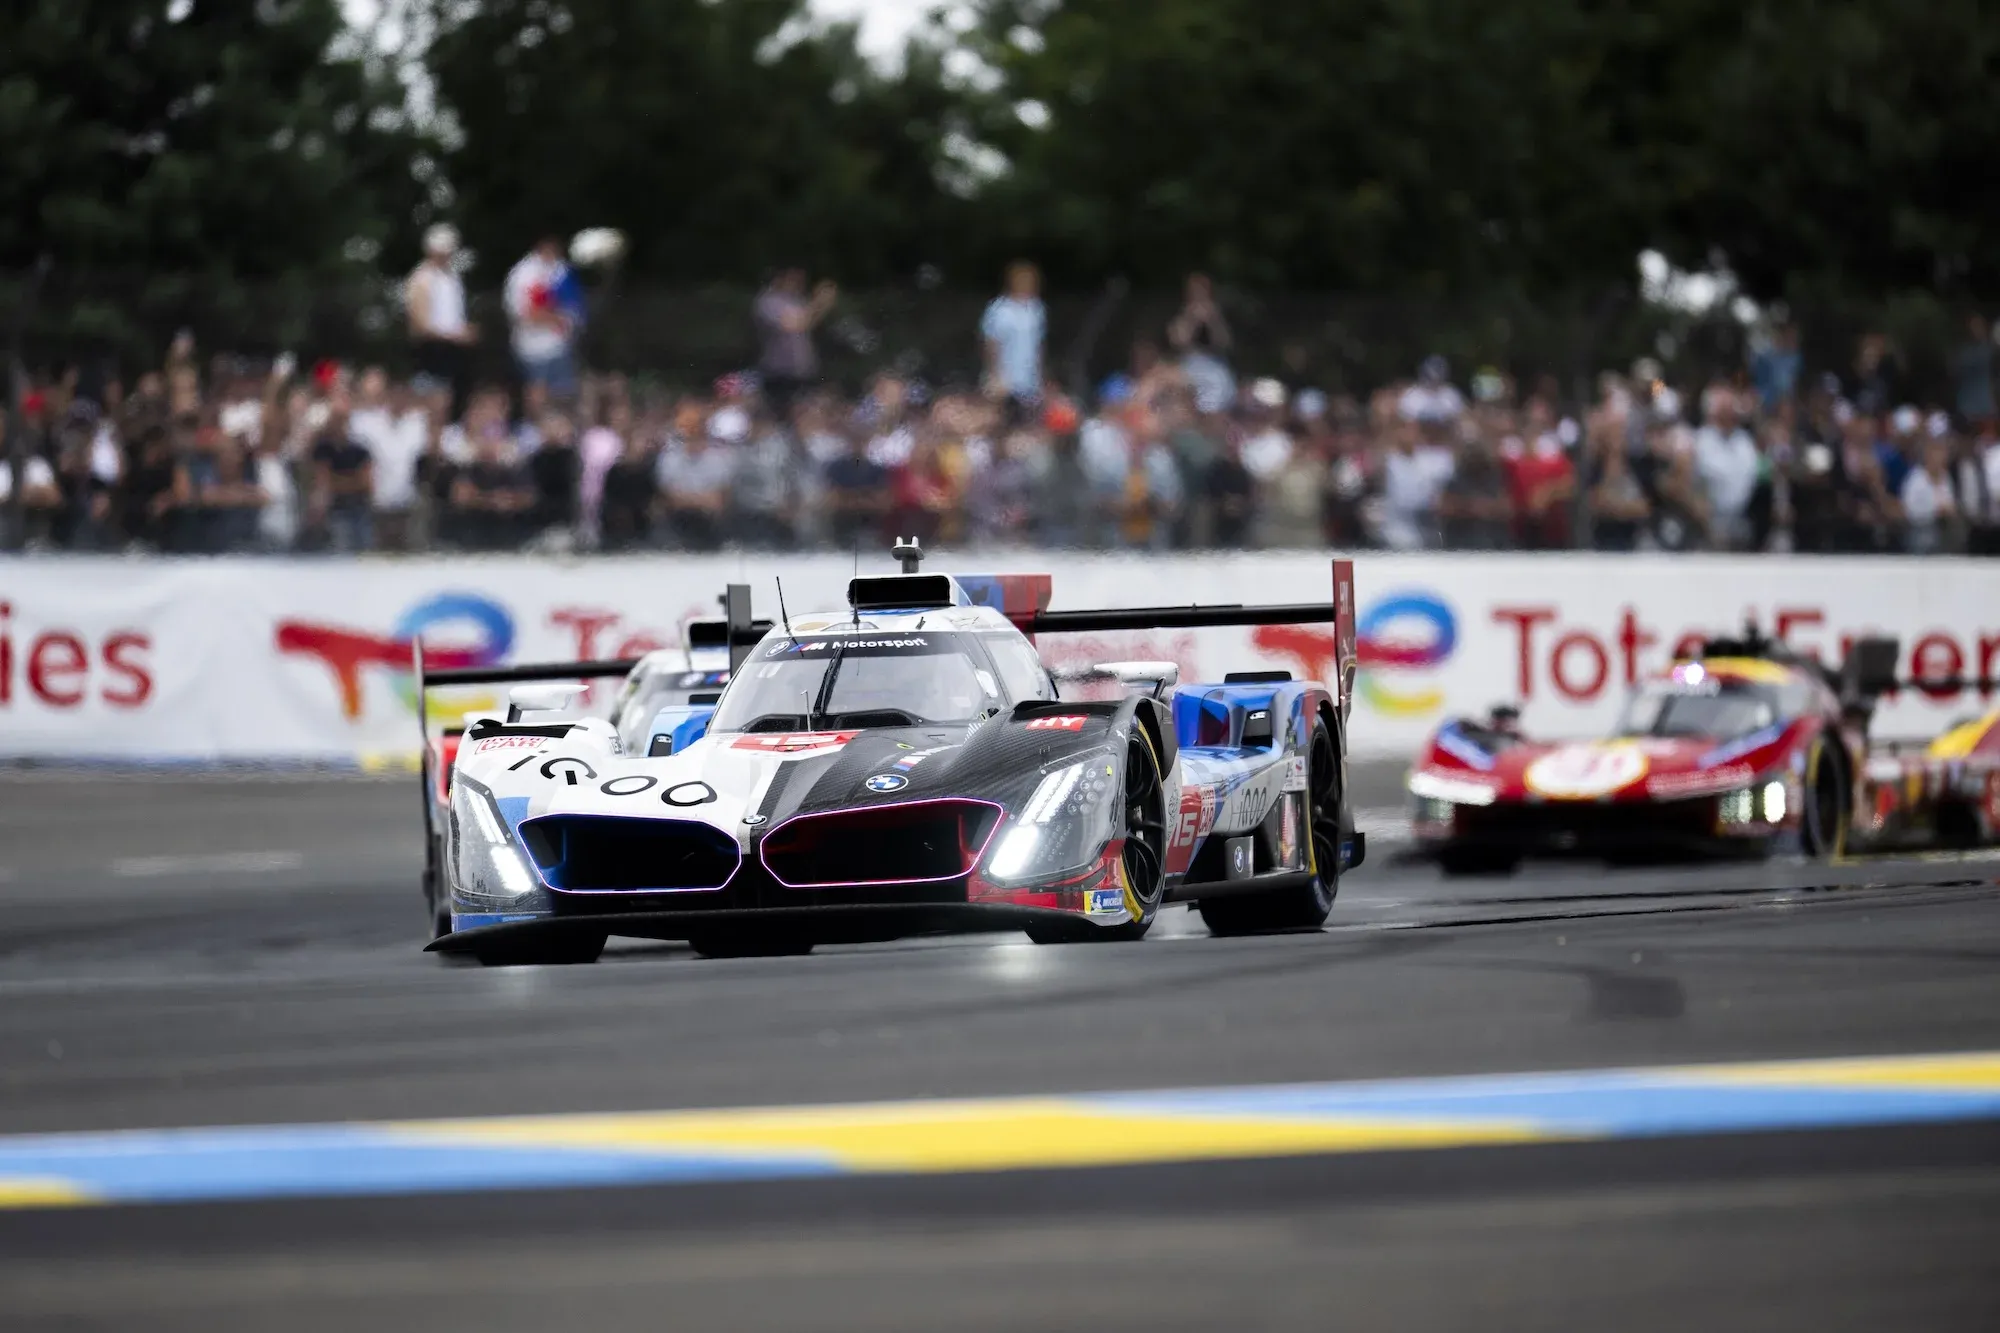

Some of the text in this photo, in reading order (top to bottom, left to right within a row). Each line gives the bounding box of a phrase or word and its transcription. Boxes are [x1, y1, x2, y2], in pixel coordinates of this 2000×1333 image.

[832, 638, 928, 650] Motorsport
[1491, 604, 2000, 704] TotEer
[1030, 716, 1082, 727] HY
[481, 740, 537, 751] CAR
